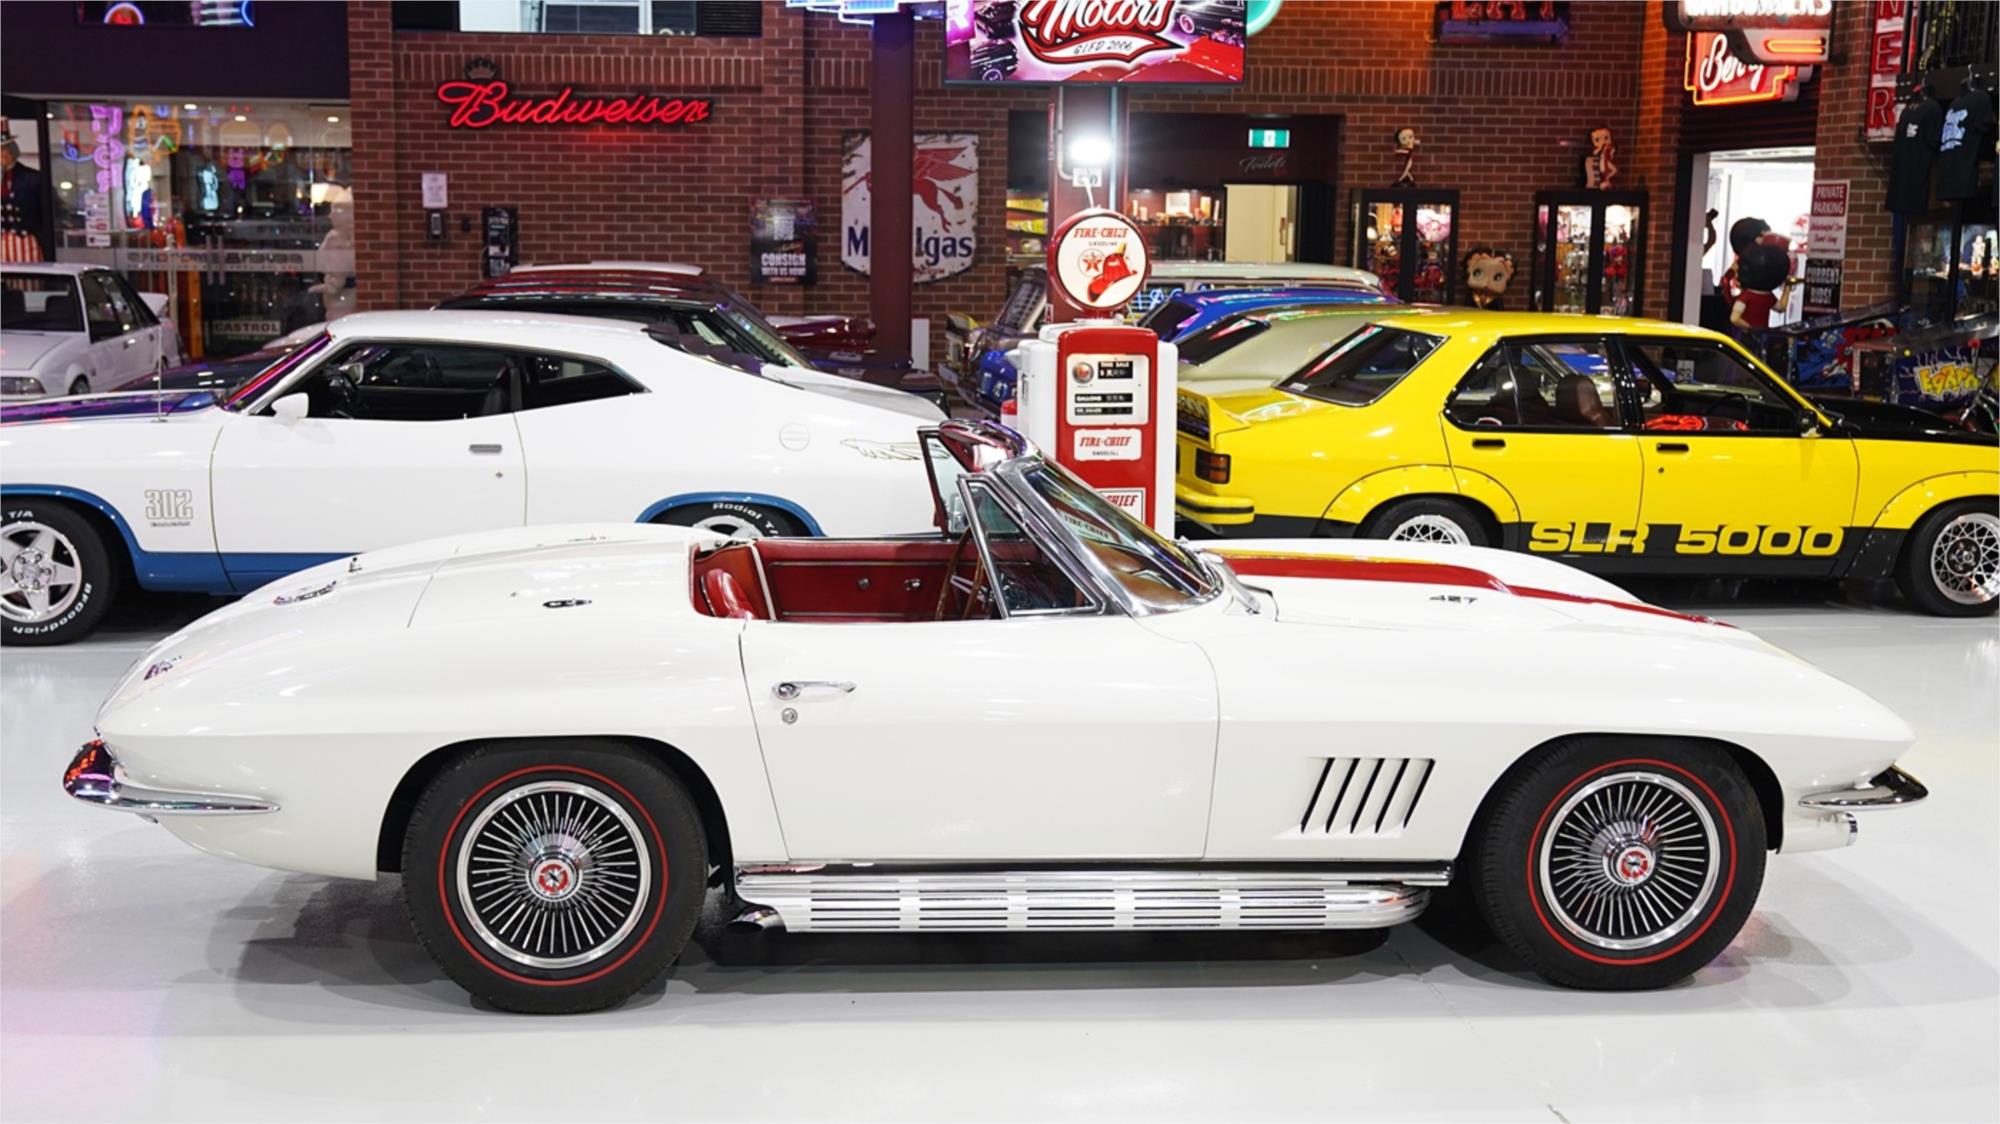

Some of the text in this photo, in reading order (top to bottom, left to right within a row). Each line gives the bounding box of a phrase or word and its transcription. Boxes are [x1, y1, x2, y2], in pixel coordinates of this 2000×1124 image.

[437, 81, 710, 128] Budweiser
[1815, 185, 1845, 199] PRIVATE
[1813, 201, 1844, 215] PARKING
[1074, 227, 1128, 238] FIRE-CHIEF
[848, 226, 972, 266] Mlgas
[761, 252, 806, 266] CONSIGN
[1806, 266, 1840, 285] CURRENT
[215, 322, 278, 332] CASTROL
[1080, 436, 1132, 447] FIRE-CHIEF
[144, 489, 193, 520] 302
[712, 502, 762, 519] Radial
[8, 510, 33, 518] T/A
[1528, 521, 1650, 554] SLR
[1674, 525, 1843, 556] 5000
[1429, 594, 1478, 603] 427
[12, 582, 93, 635] BFGoodrich
